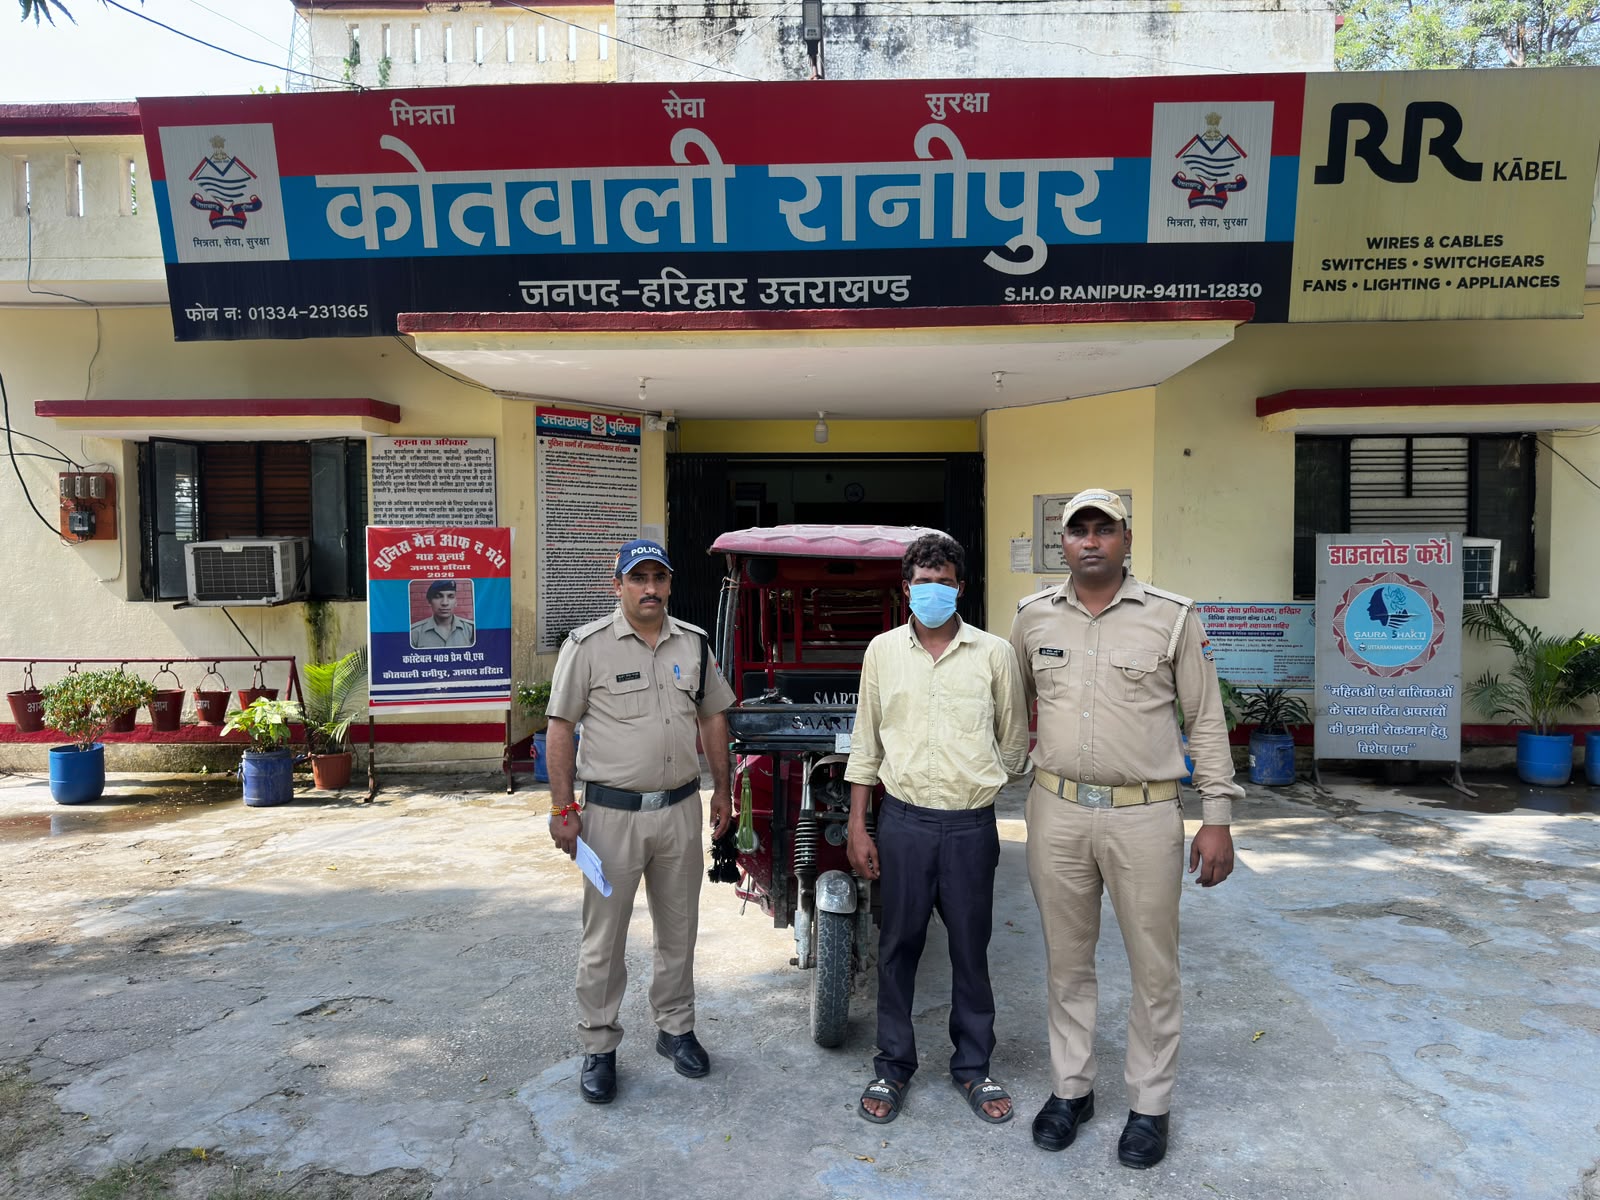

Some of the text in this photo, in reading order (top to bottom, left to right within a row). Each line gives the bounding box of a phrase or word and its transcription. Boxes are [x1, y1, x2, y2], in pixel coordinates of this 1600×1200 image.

[661, 89, 705, 119] सेवा
[925, 92, 990, 121] सुरक्षा
[390, 99, 455, 126] मित्रता
[1493, 157, 1567, 182] KĀBEL
[316, 123, 1114, 276] कोतवाली रानीपुर
[1167, 215, 1248, 230] मित्रता, सेवा, सुरक्षा
[192, 236, 270, 249] मित्रता, सेवा, सुरक्षा
[1366, 234, 1503, 250] WIRES & CABLES
[1321, 255, 1545, 271] SWITCHES SWITCHGEARS
[518, 266, 912, 309] जनपद-हरिद्वार उत्तराखण्ड
[1303, 275, 1560, 292] FANS LIGHTING APPLIANCES
[1004, 283, 1263, 301] S.H.O RANIPUR-94111-12830
[185, 303, 219, 322] फोन
[248, 304, 369, 321] 01334-231365
[541, 413, 636, 436] उत्तराखण्ड पुलिस
[435, 438, 469, 446] अधिकार
[373, 539, 412, 572] पुलिस
[412, 532, 436, 548] मैन
[474, 540, 484, 555] द
[415, 551, 465, 563] माह जुलाई
[631, 546, 664, 557] POLICE
[1328, 539, 1410, 566] डाउनलोड
[1353, 631, 1387, 639] GAURA
[382, 669, 419, 679] कोतवाली
[421, 668, 450, 679] रानीपुर,
[452, 667, 478, 676] जनपद
[1379, 684, 1396, 698] एवं
[153, 701, 168, 712] आग
[196, 700, 210, 710] आग
[1328, 702, 1448, 717] के साथ घटित अपराधों
[1328, 721, 1448, 739] की प्रभावी रोकथाम हेतु
[1357, 741, 1388, 754] विशेष
